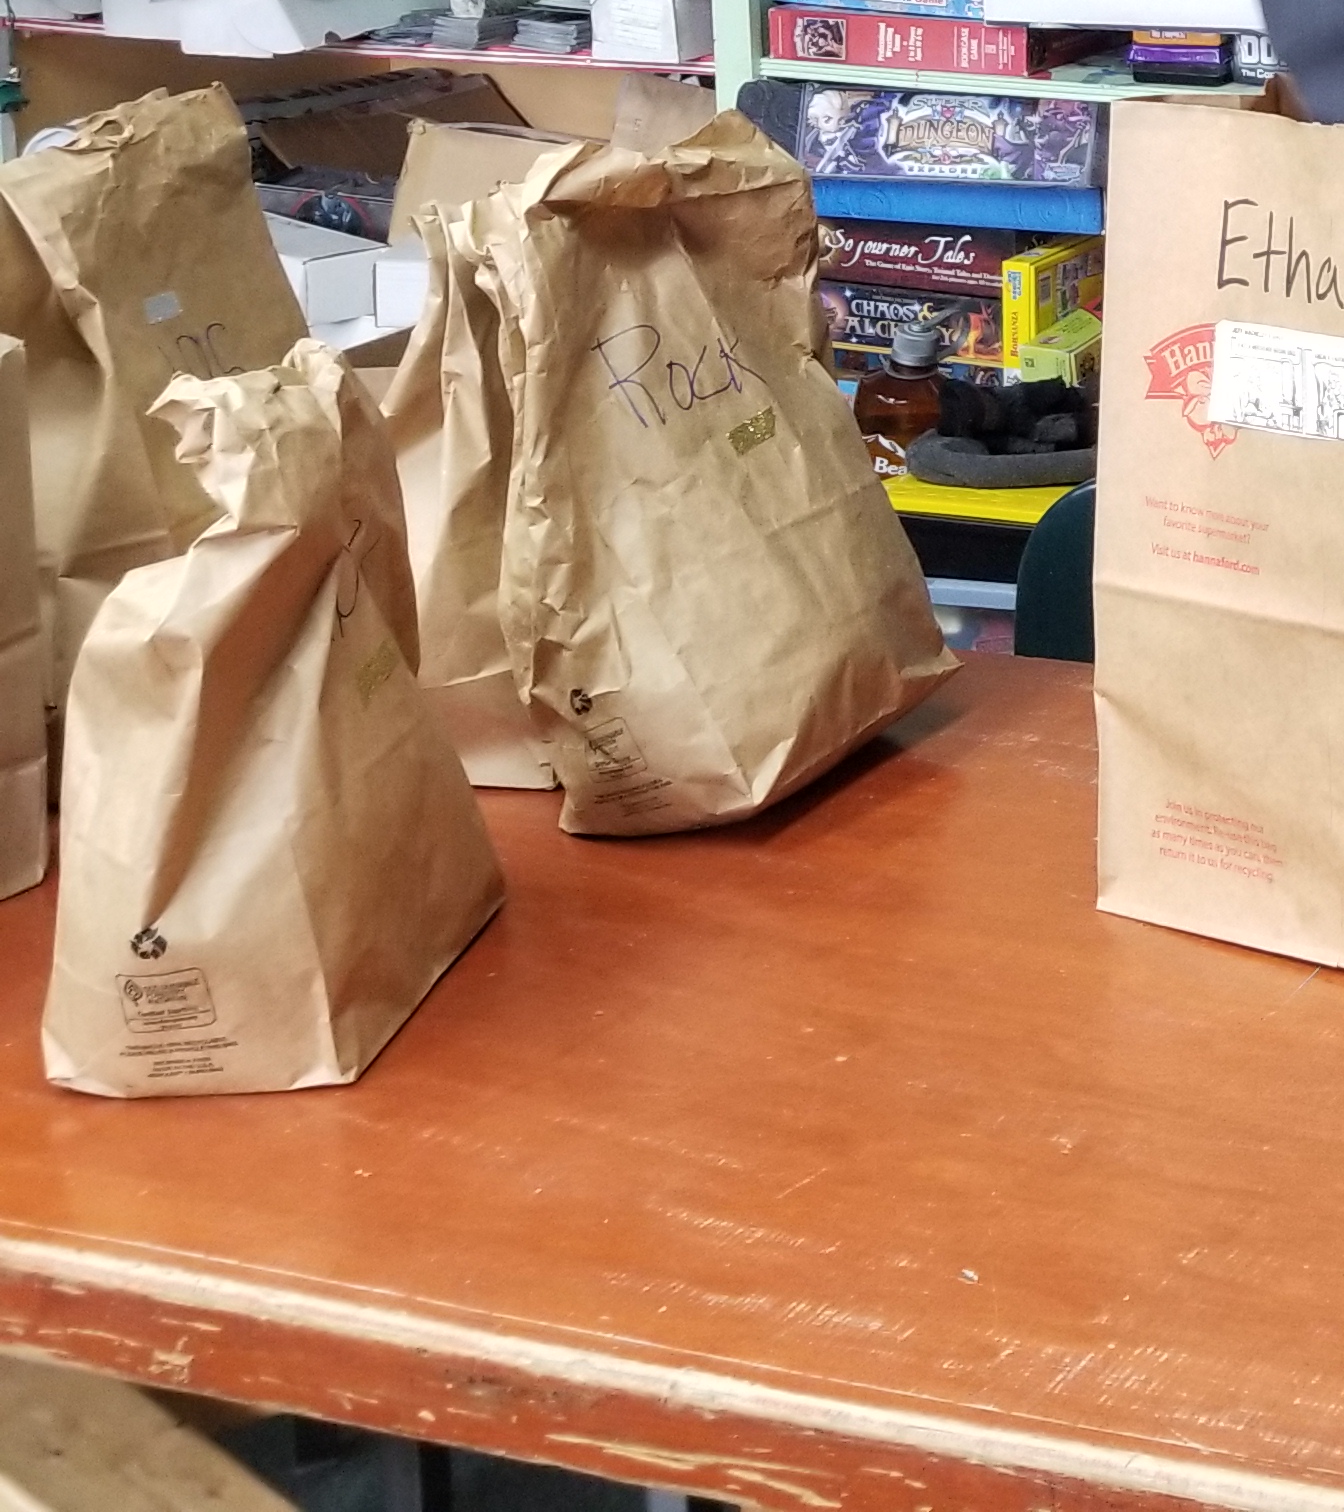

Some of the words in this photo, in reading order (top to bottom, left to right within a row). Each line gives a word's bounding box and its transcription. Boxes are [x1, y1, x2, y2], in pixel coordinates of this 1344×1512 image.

[898, 119, 996, 152] DUNGEON
[907, 165, 980, 176] EXPLORE
[826, 229, 919, 267] Sojourner
[917, 235, 976, 265] Tales
[851, 299, 917, 321] CHAOS
[917, 302, 937, 322] &
[1145, 495, 1168, 510] Want
[1169, 502, 1180, 512] to
[1180, 501, 1205, 517] know
[1163, 515, 1197, 533] favorite
[1151, 541, 1170, 558] Visit
[1170, 549, 1182, 559] us
[1181, 550, 1192, 562] at
[1192, 550, 1261, 576] hannaford.com
